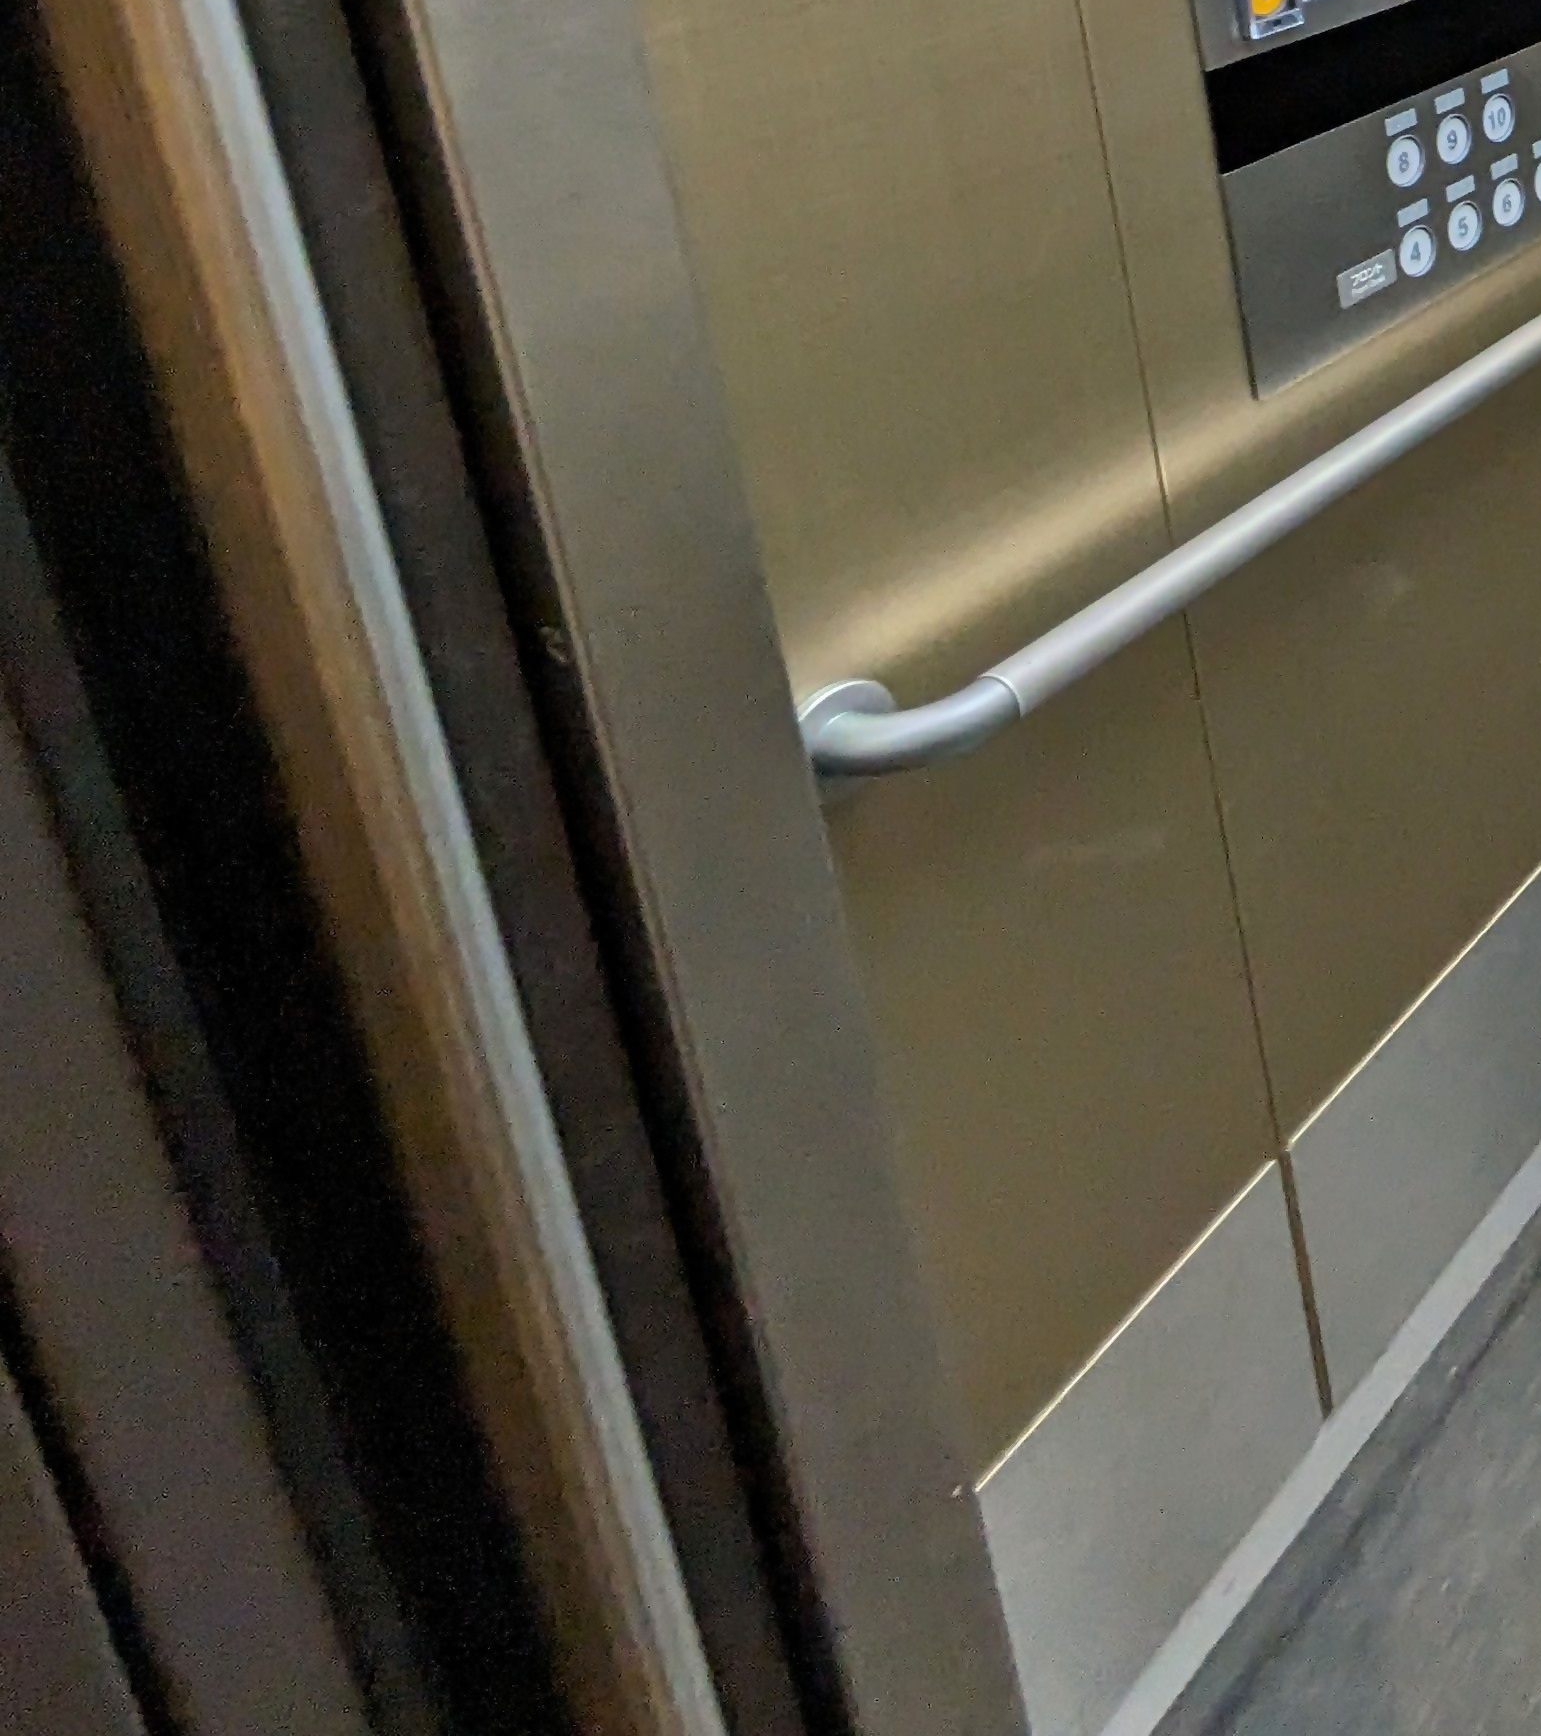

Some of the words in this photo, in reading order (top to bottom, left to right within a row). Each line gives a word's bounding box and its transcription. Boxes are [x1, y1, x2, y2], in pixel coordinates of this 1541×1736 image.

[1399, 151, 1410, 174] 8
[1446, 130, 1458, 151] 9
[1487, 107, 1506, 128] 10
[1410, 241, 1422, 262] 4
[1458, 215, 1469, 237] 5
[1502, 195, 1513, 214] 6
